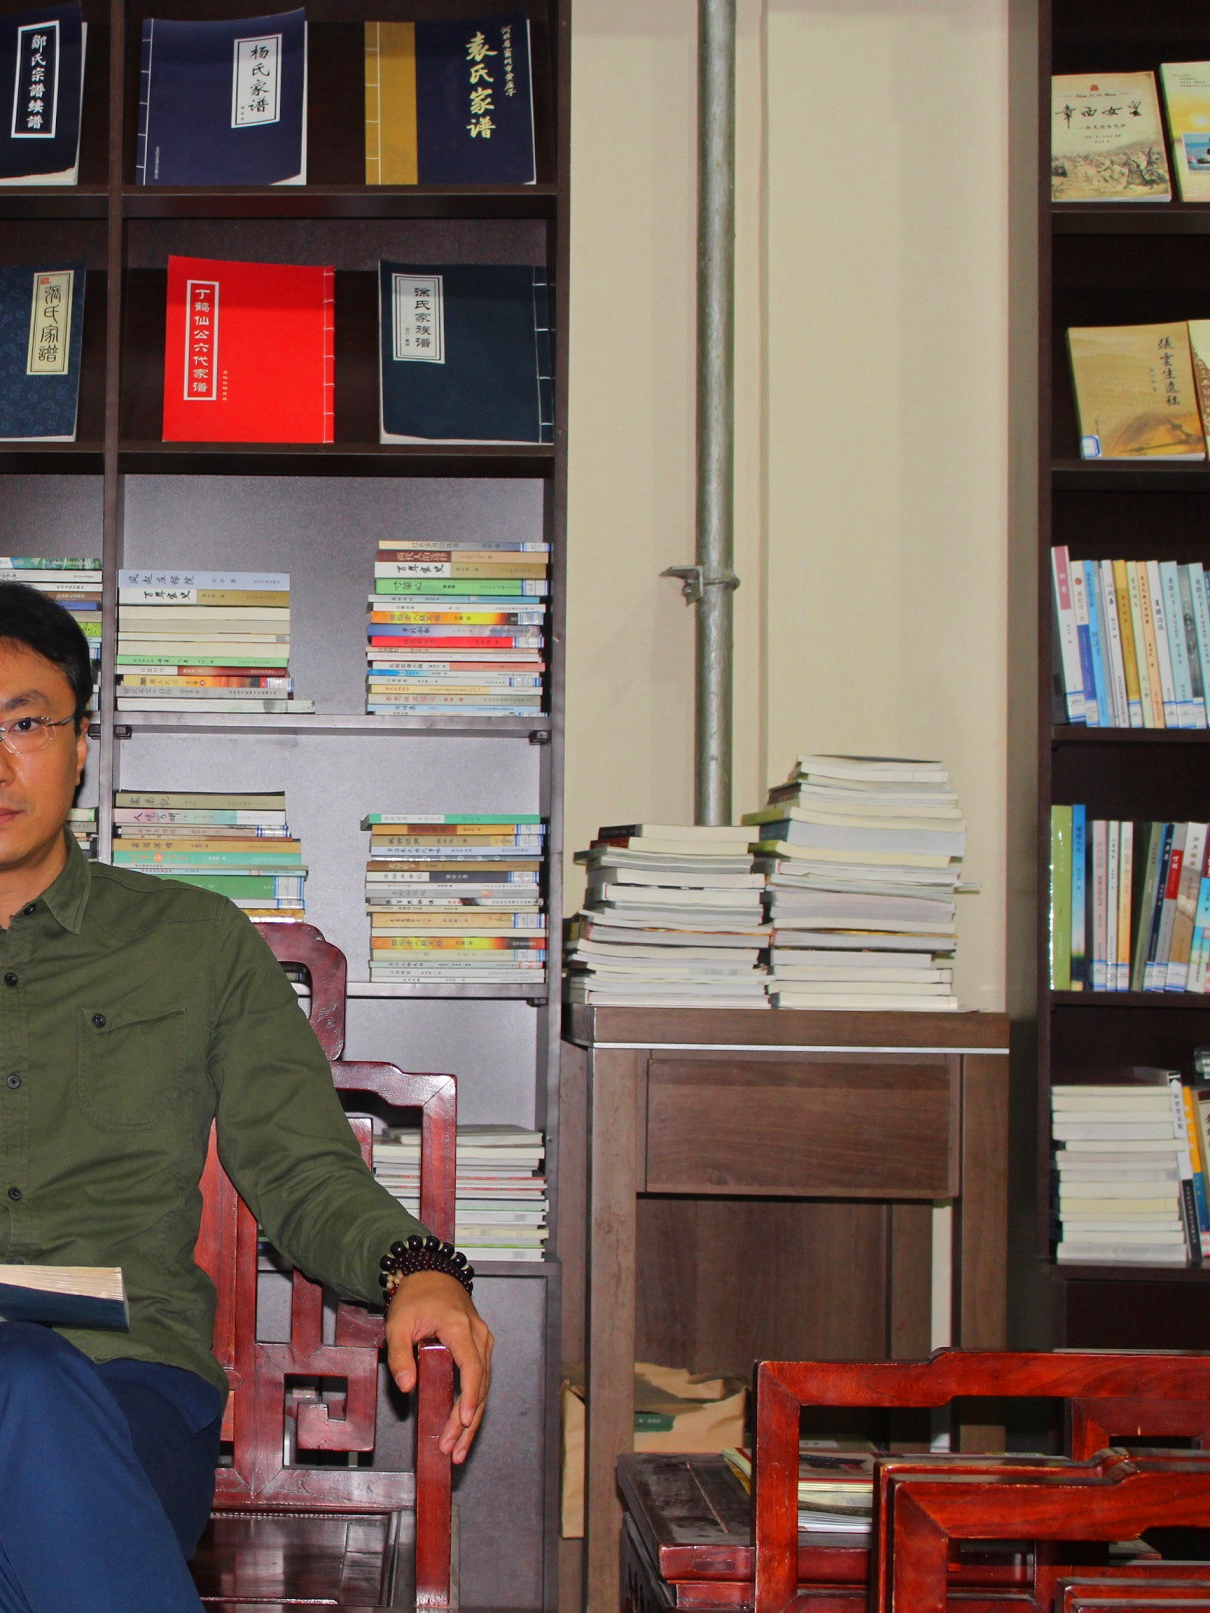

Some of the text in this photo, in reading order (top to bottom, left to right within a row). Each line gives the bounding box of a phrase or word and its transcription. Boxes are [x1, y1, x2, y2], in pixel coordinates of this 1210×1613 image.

[248, 45, 270, 112] 杨氏家谱
[466, 31, 498, 139] 袁氏家谱
